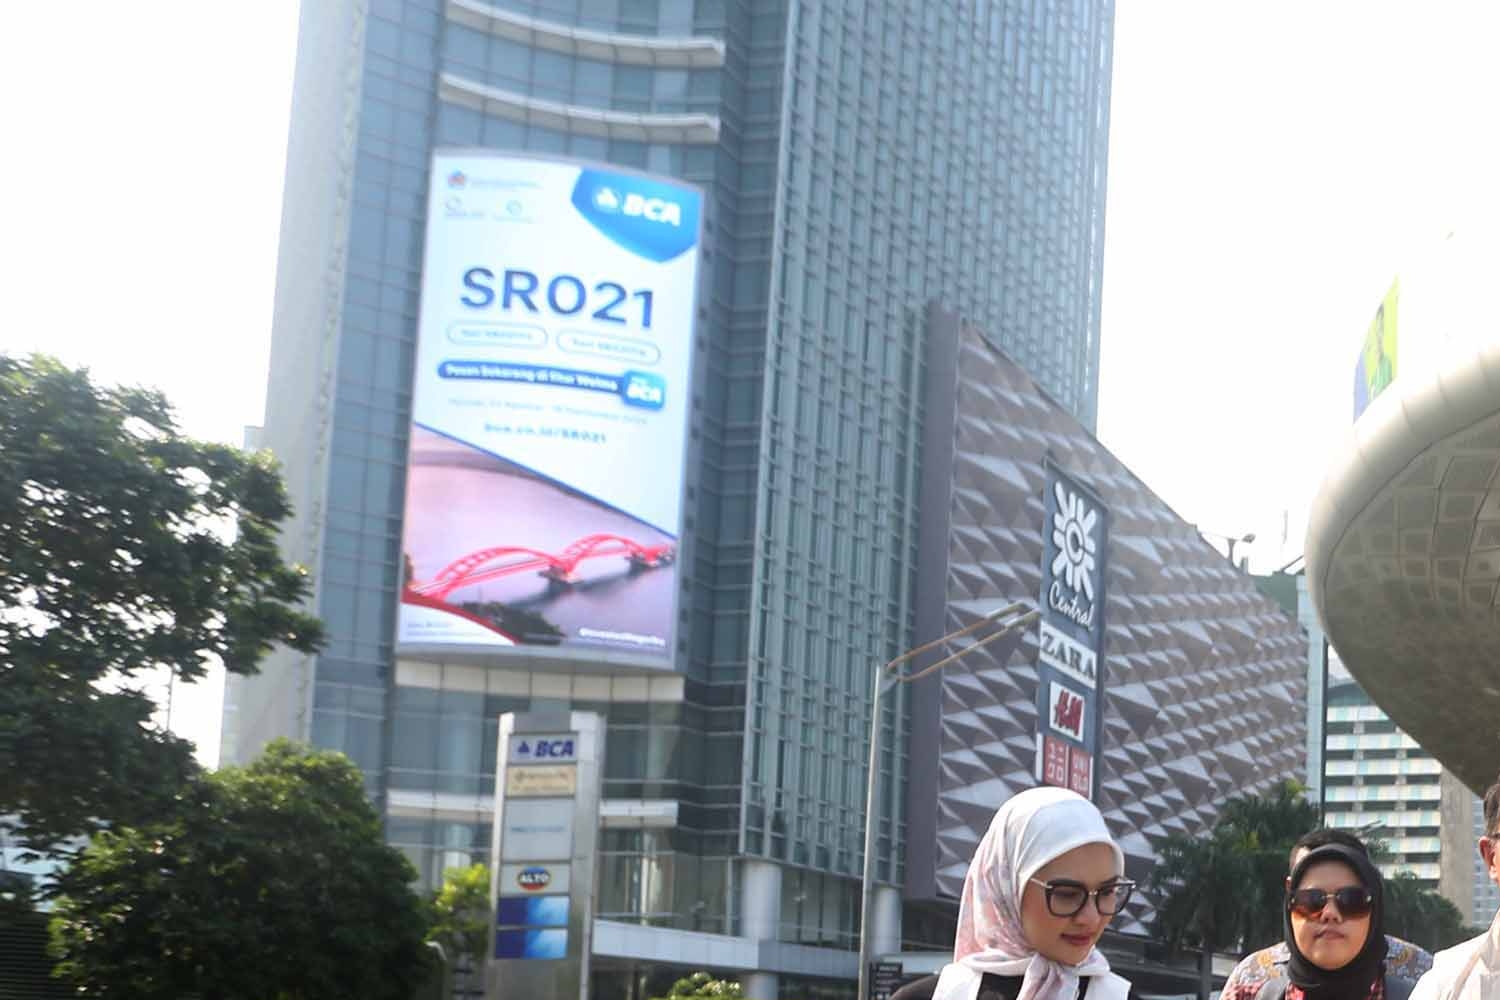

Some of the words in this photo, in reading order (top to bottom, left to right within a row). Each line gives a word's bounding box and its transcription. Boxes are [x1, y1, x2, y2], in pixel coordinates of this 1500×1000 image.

[624, 192, 681, 227] BCA
[1050, 580, 1095, 631] Central
[1042, 632, 1095, 680] ZARA
[534, 739, 574, 758] BCA
